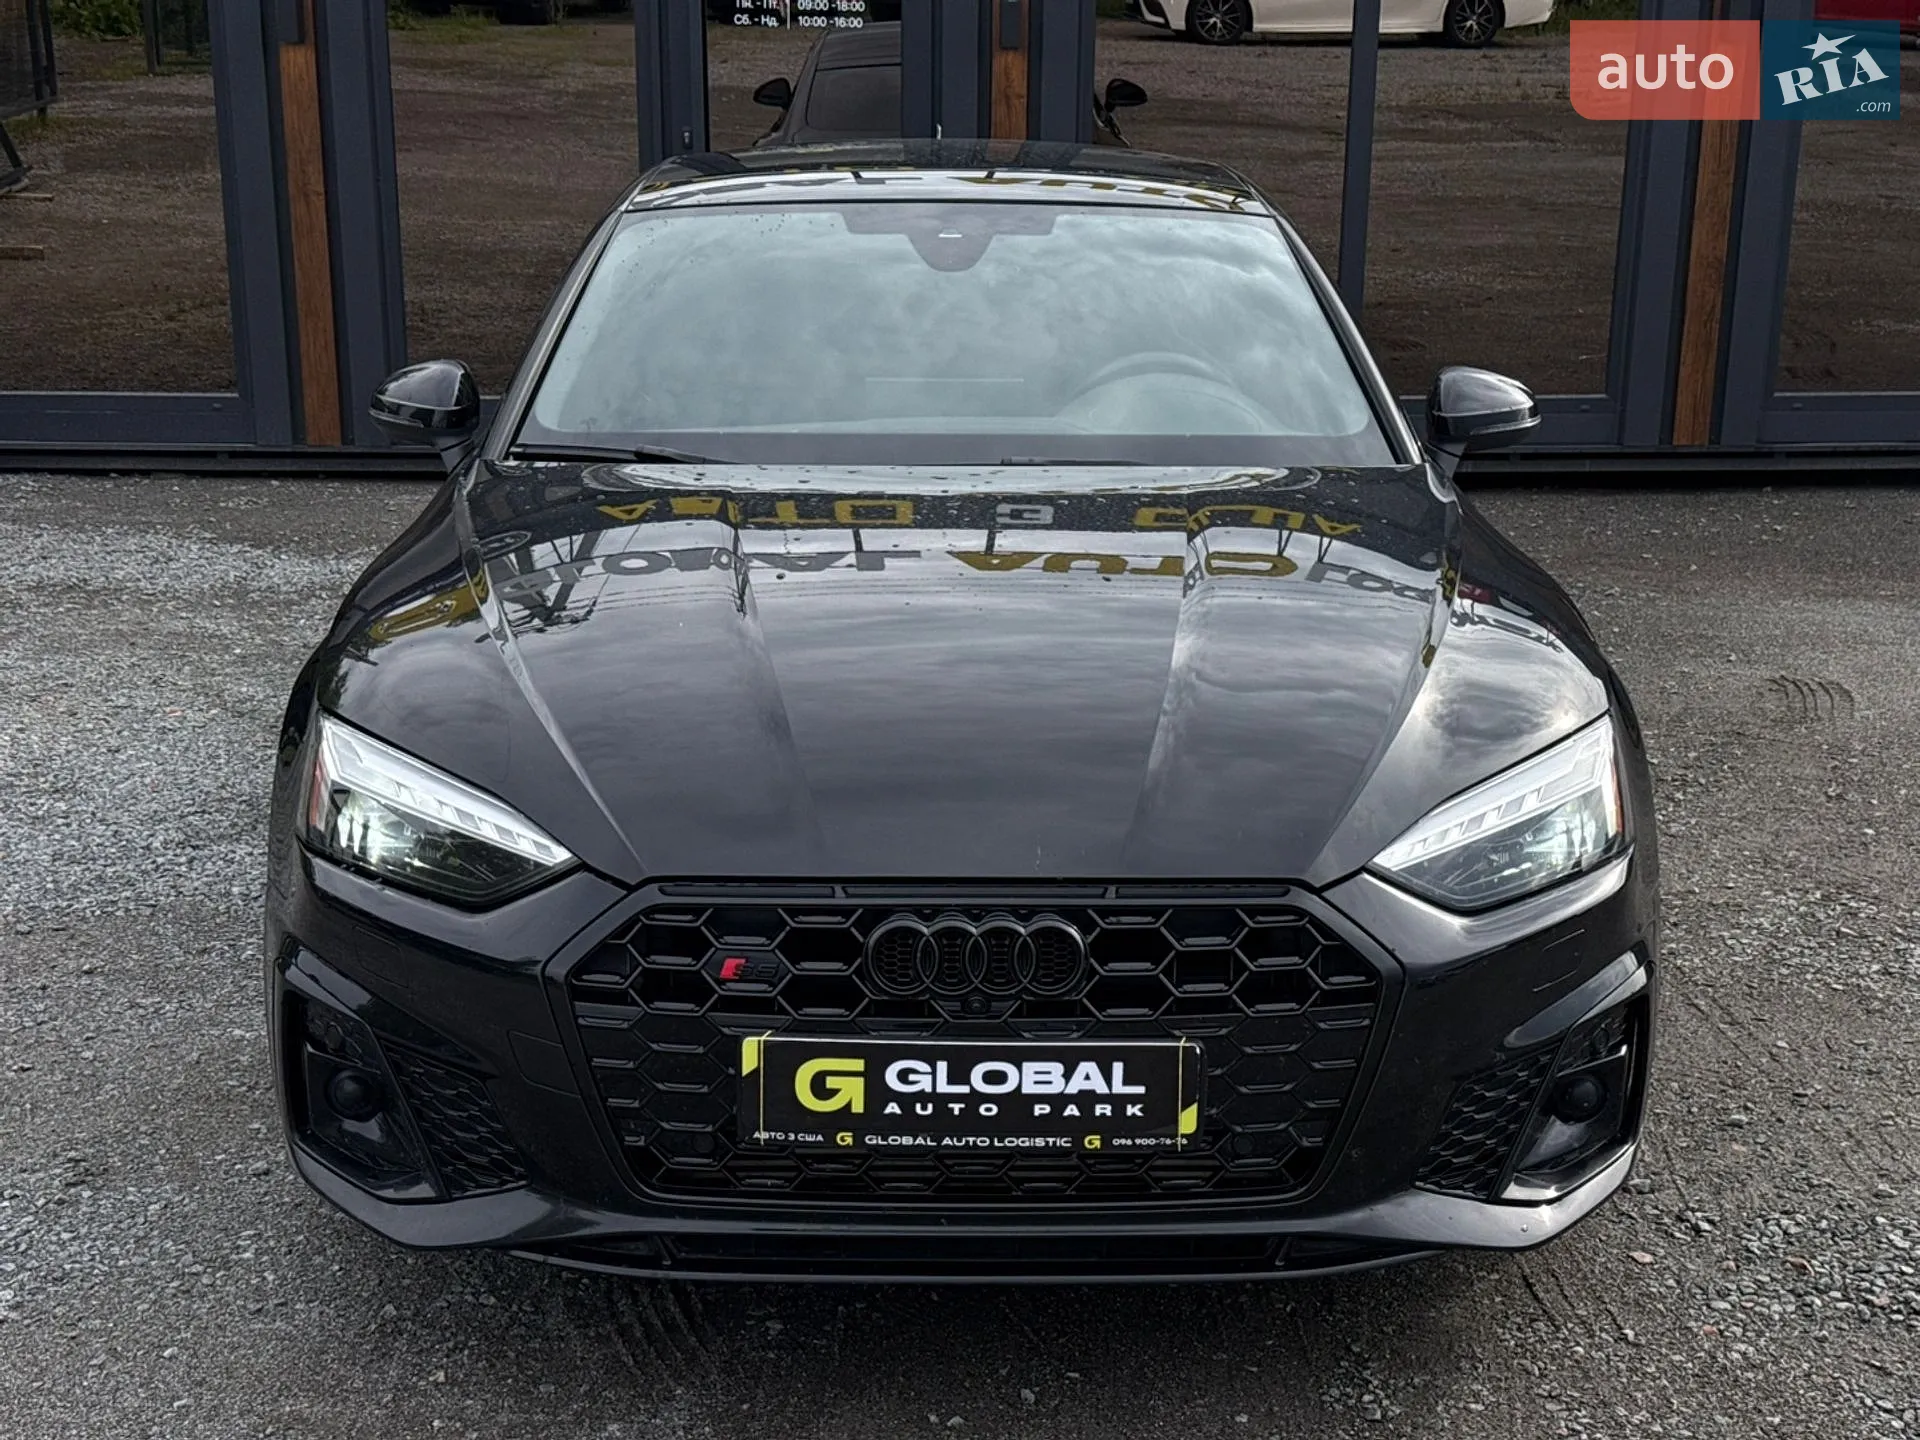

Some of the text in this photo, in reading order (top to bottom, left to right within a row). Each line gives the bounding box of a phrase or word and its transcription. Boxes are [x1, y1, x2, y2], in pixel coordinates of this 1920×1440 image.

[797, 0, 829, 11] 09:00
[734, 14, 752, 25] Сб.
[761, 15, 780, 27] Нд.
[798, 16, 827, 27] 10:00
[884, 1059, 1146, 1095] GLOBAL
[882, 1101, 1145, 1118] AUTO PARK
[797, 1132, 825, 1143] США
[864, 1134, 1073, 1147] GLOBAL AUTO LOGISTIC
[1112, 1137, 1133, 1147] 096
